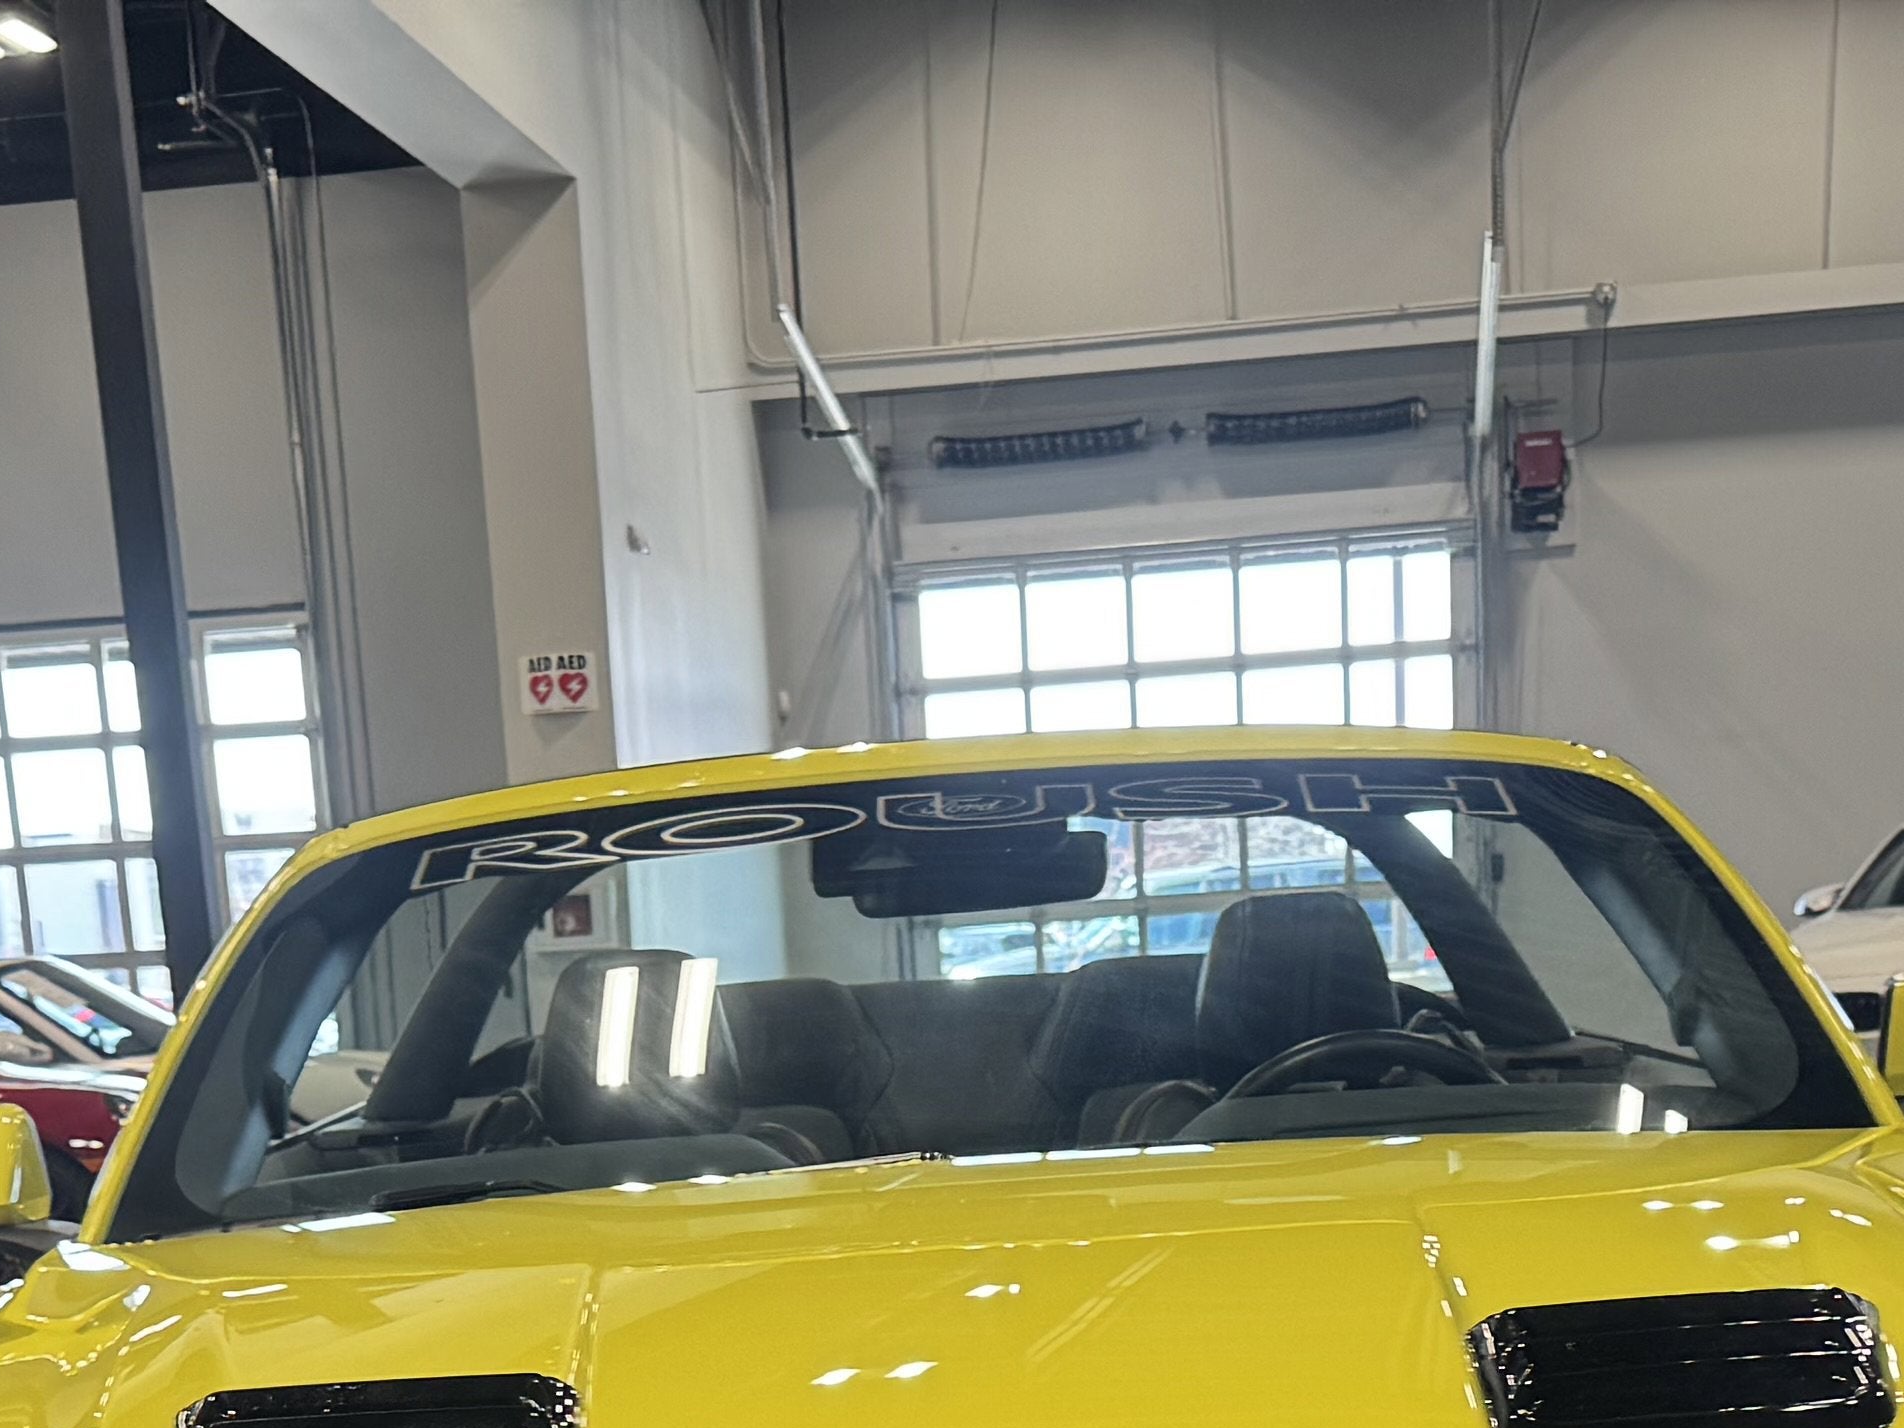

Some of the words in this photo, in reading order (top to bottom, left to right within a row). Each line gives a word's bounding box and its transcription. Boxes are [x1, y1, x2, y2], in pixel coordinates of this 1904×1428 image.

[528, 656, 553, 673] AED
[555, 654, 587, 670] AED
[409, 773, 1518, 891] ROUSH
